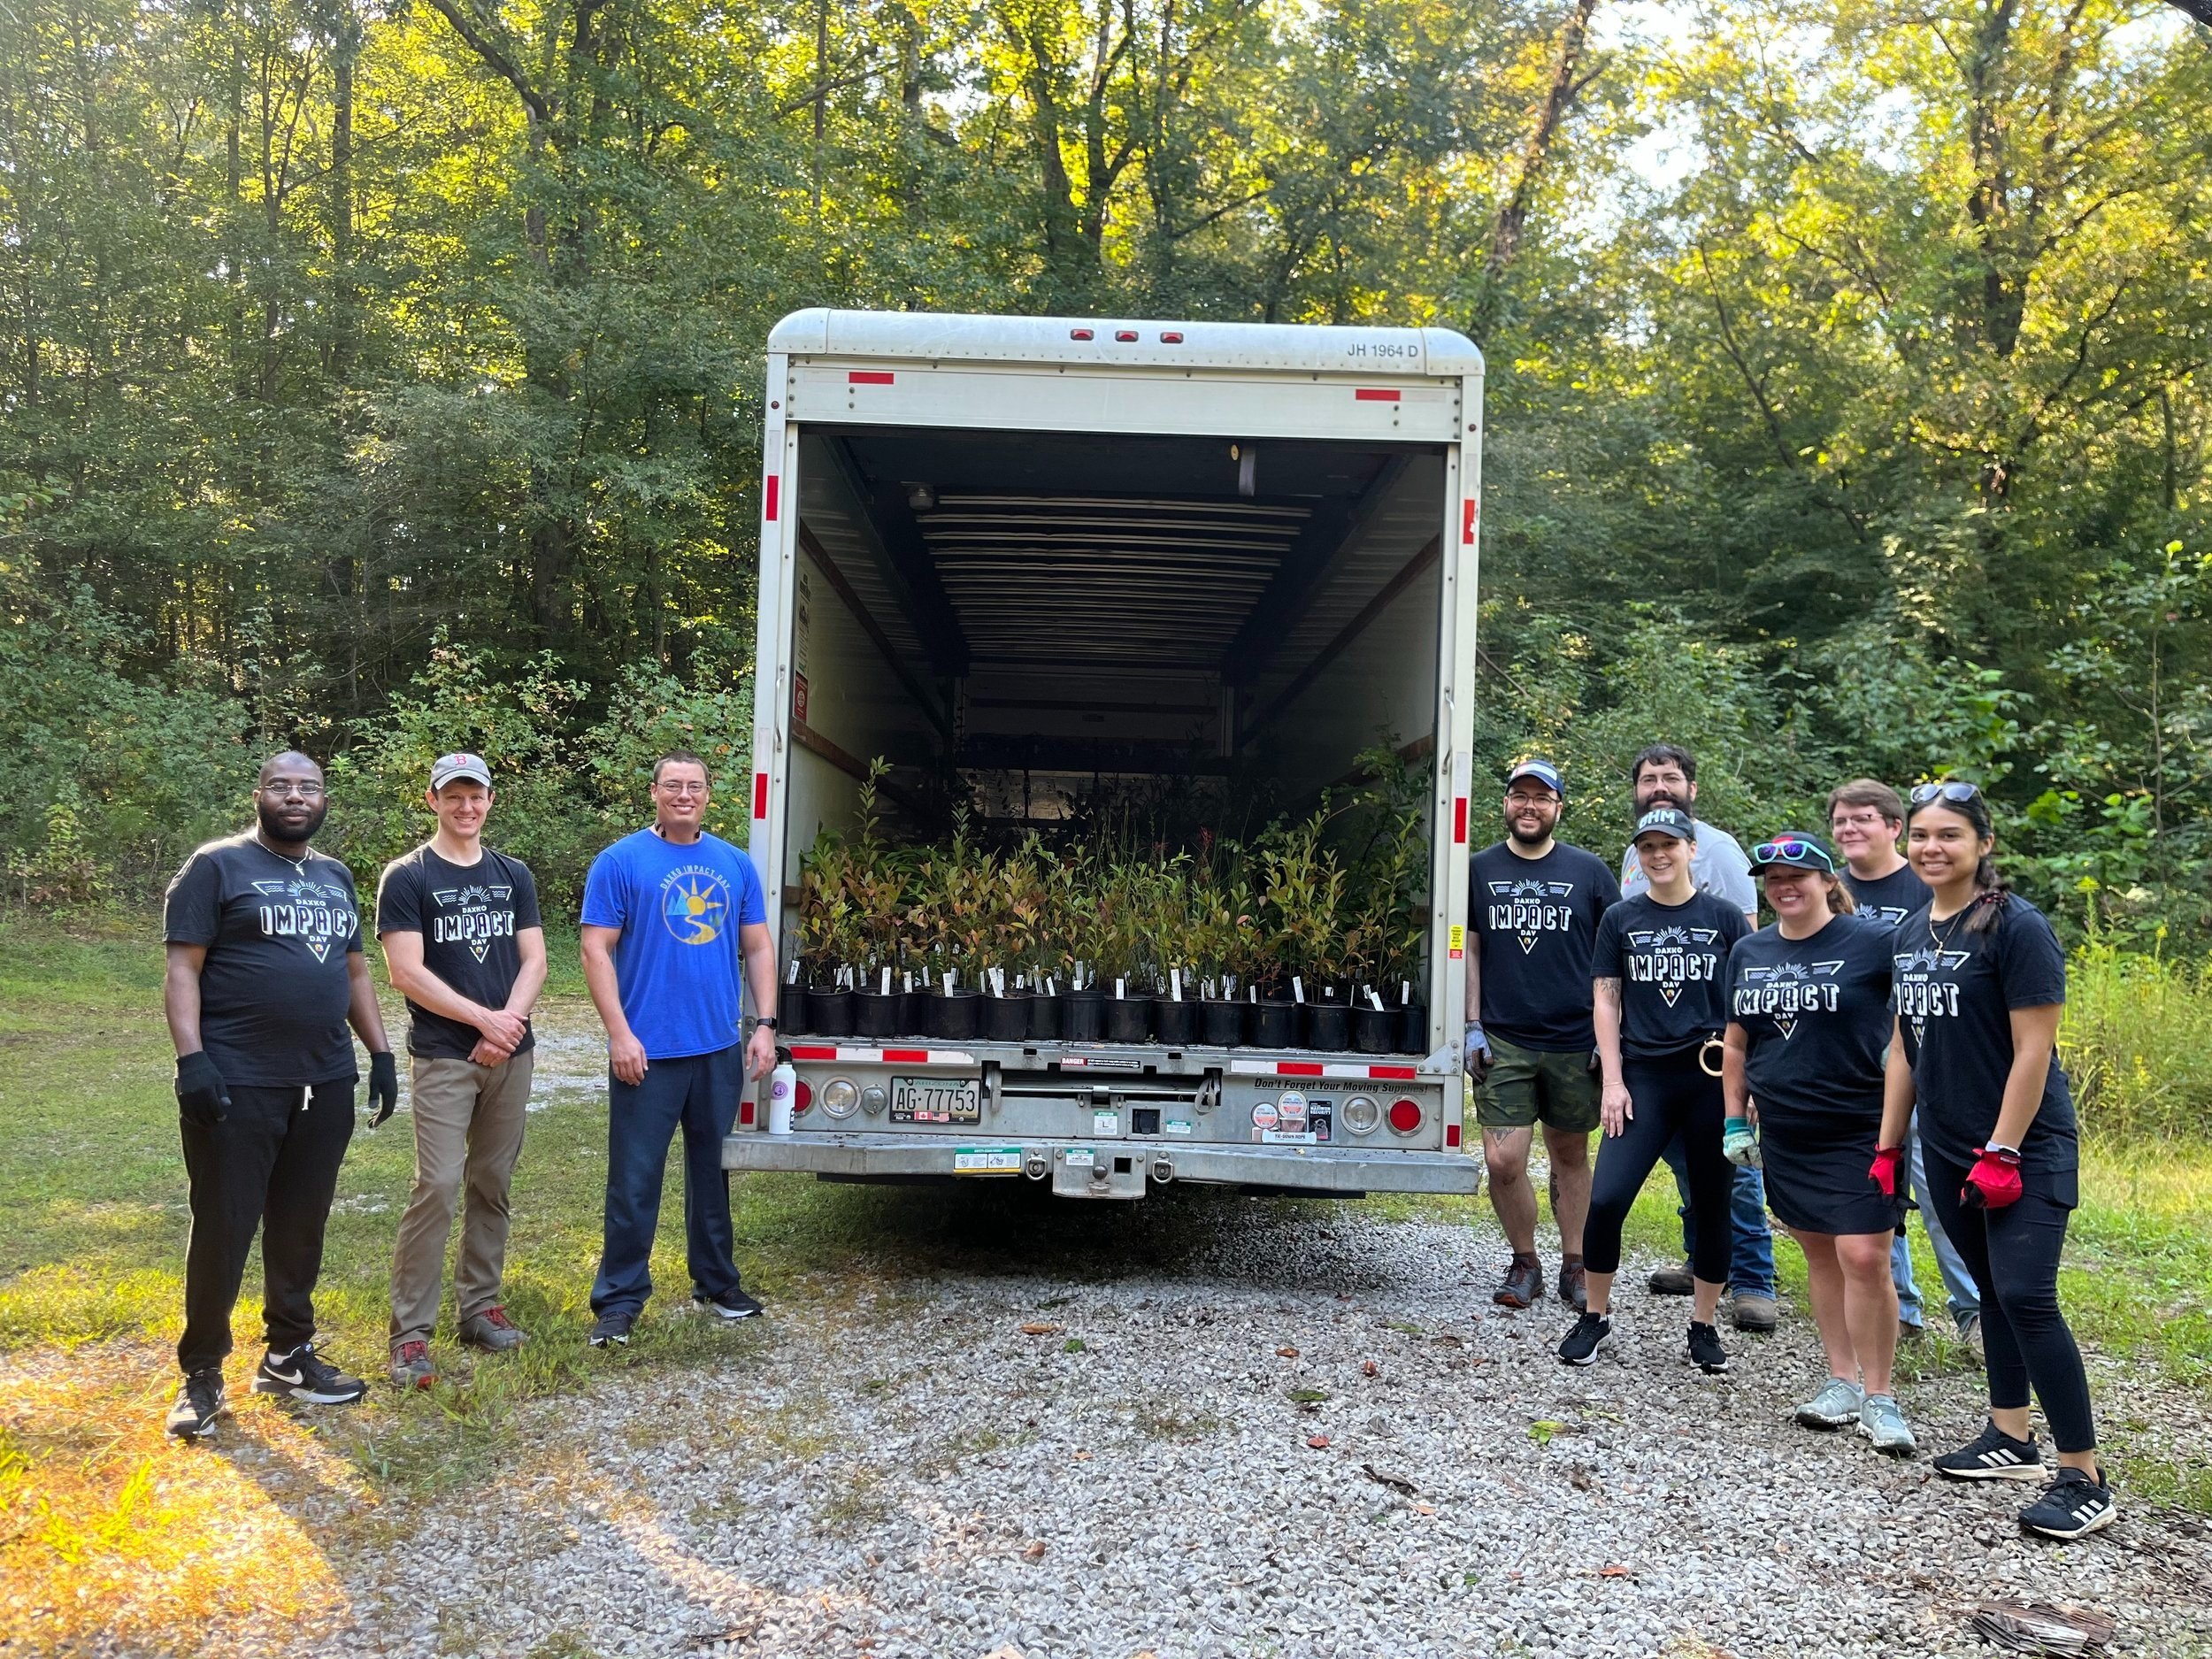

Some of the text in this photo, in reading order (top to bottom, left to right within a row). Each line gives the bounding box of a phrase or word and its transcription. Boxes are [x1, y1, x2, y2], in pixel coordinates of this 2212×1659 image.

[1348, 343, 1419, 357] JH 1964 D
[454, 755, 467, 765] B
[659, 864, 731, 890] DAXKO IMPACT DAY
[295, 898, 326, 907] DAXKO
[462, 904, 488, 914] DAXKO
[259, 904, 358, 940] IMPACT
[1488, 904, 1572, 932] IMPACT
[433, 910, 515, 943] IMPACT
[1628, 953, 1717, 981] IMPACT
[1902, 973, 1929, 982] DAXKO
[1733, 983, 1840, 1017] IMPACT
[1911, 1016, 1924, 1025] DAY
[1254, 1079, 1429, 1094] Don't Forget Your Moving Supplies!
